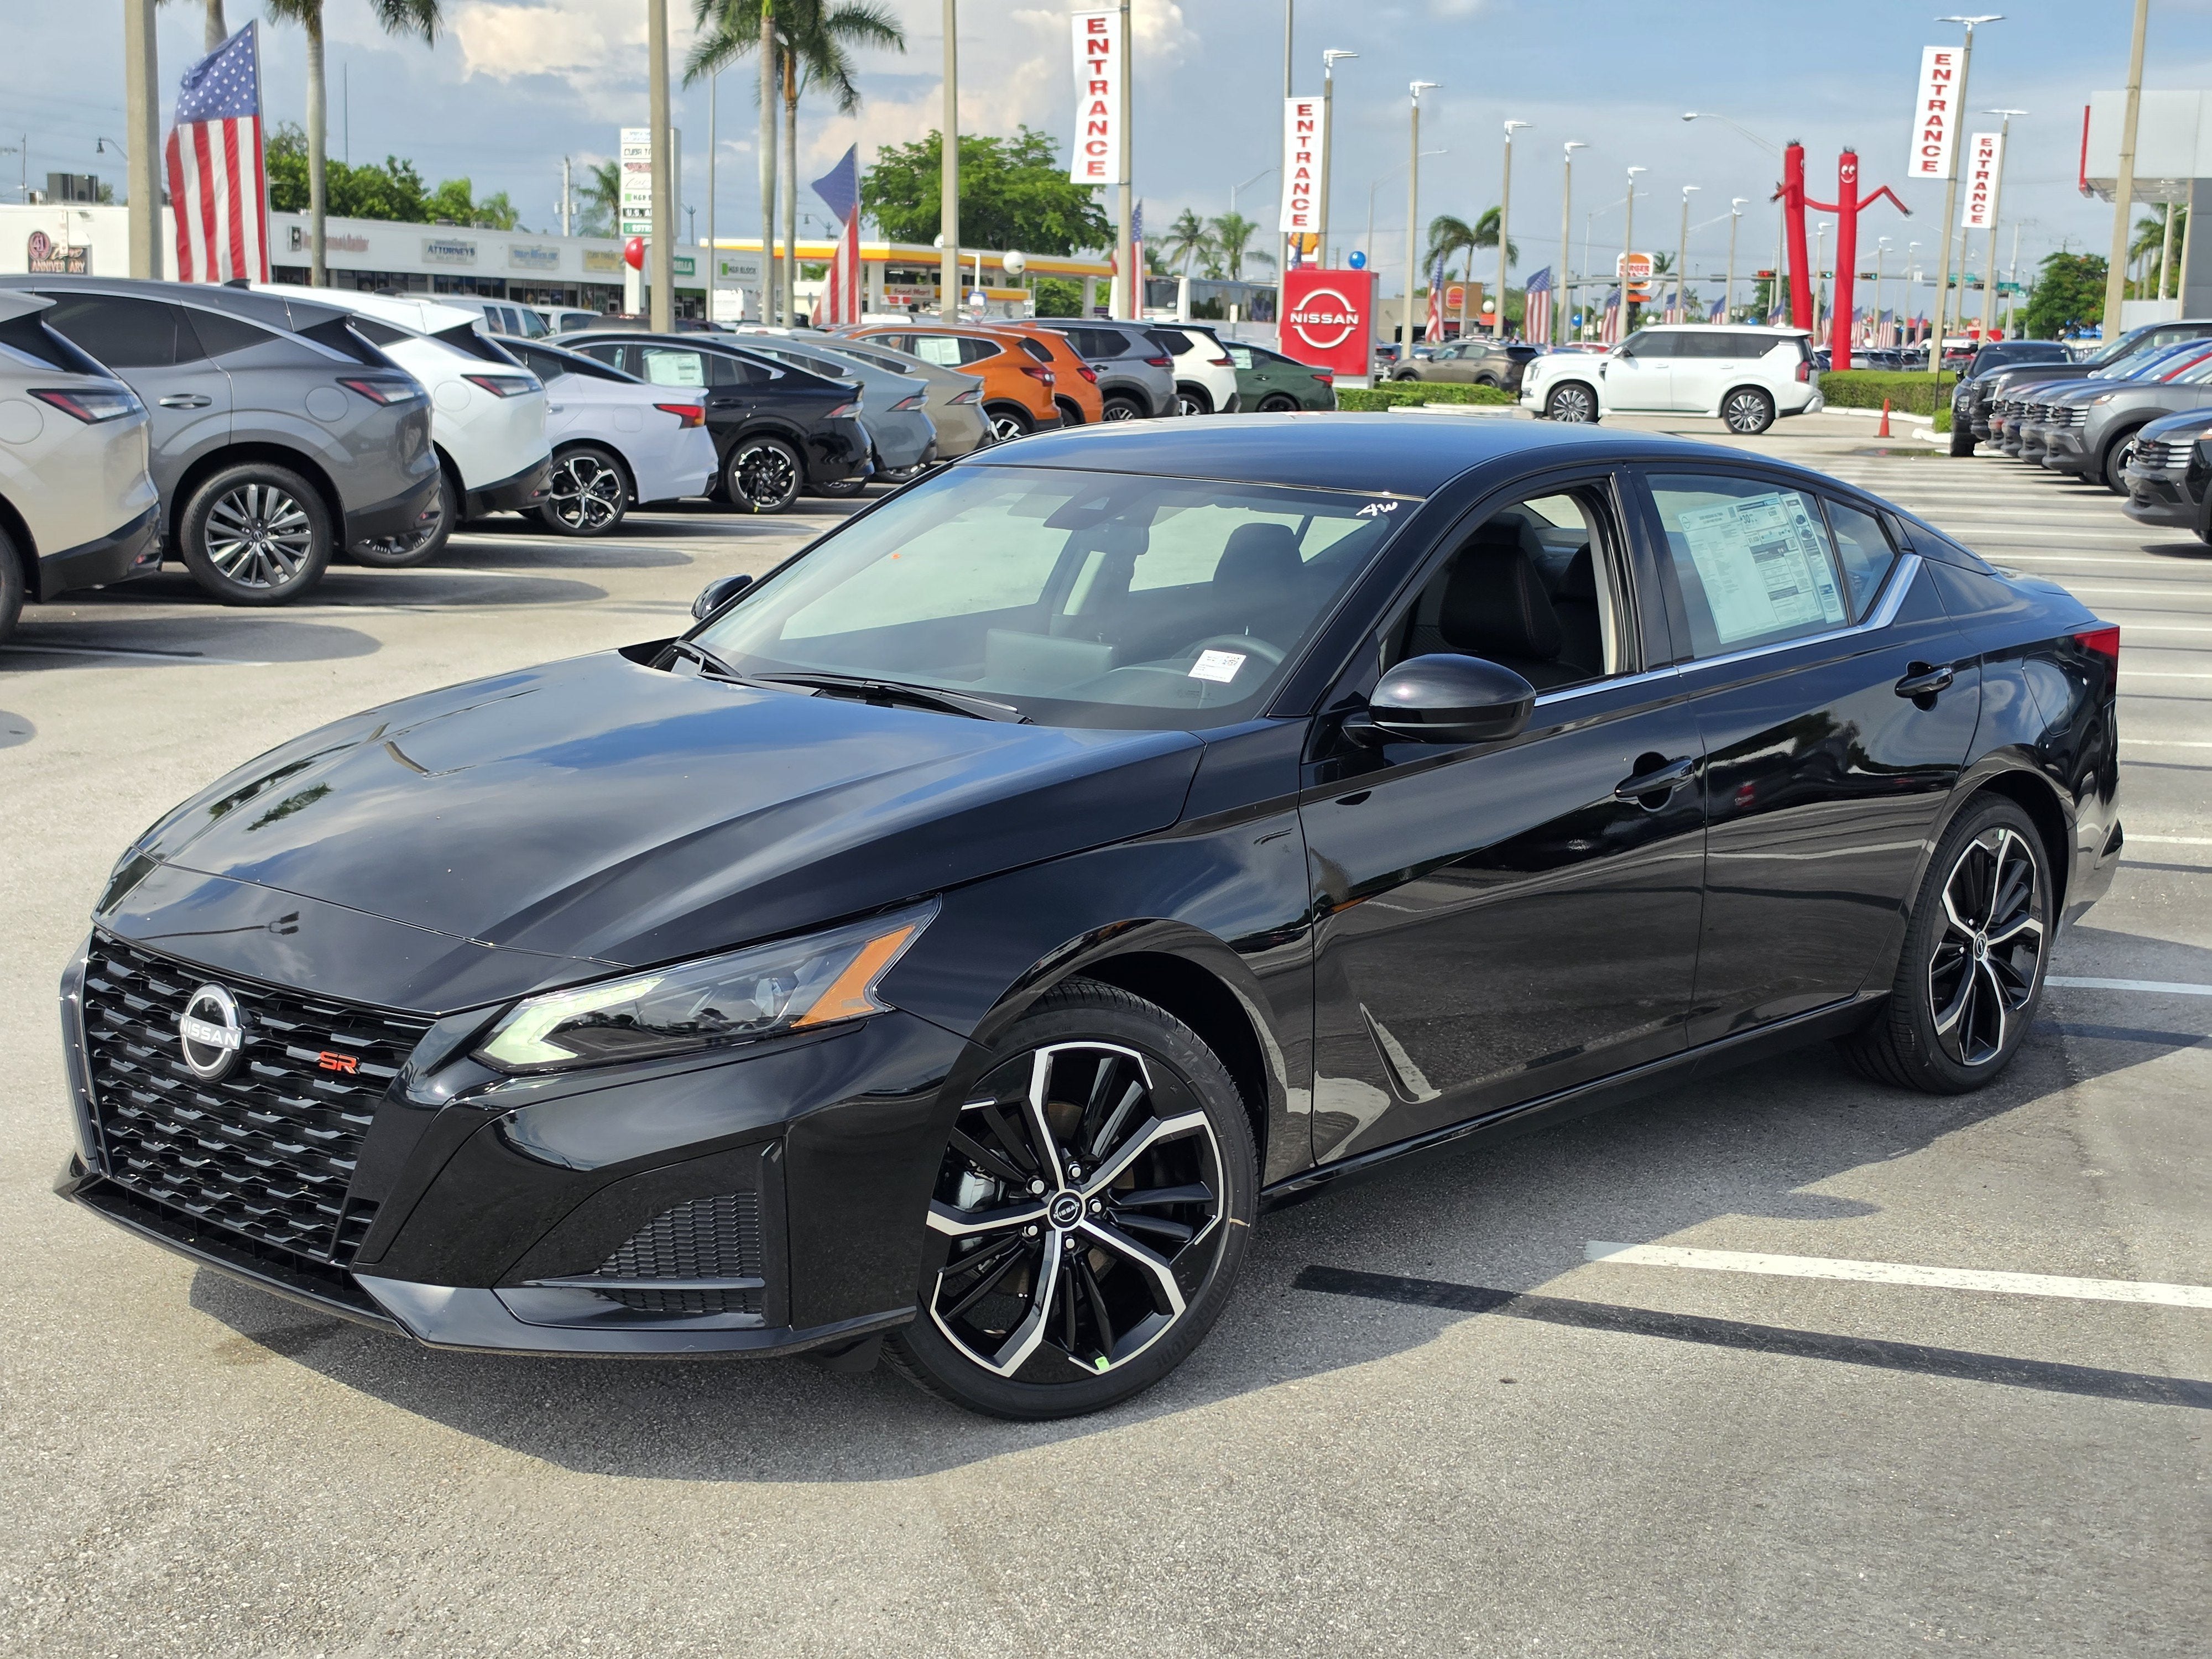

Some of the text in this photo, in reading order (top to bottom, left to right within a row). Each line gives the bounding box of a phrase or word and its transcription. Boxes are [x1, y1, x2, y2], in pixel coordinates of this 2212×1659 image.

[1085, 17, 1109, 176] ENTRANCE
[1921, 53, 1952, 173] ENTRANCE
[1291, 103, 1314, 226] ENTRANCE
[1970, 138, 1992, 224] ENTRANCE
[1290, 312, 1359, 325] NISSAN
[180, 1017, 238, 1047] NISSAN
[319, 1051, 357, 1074] SR
